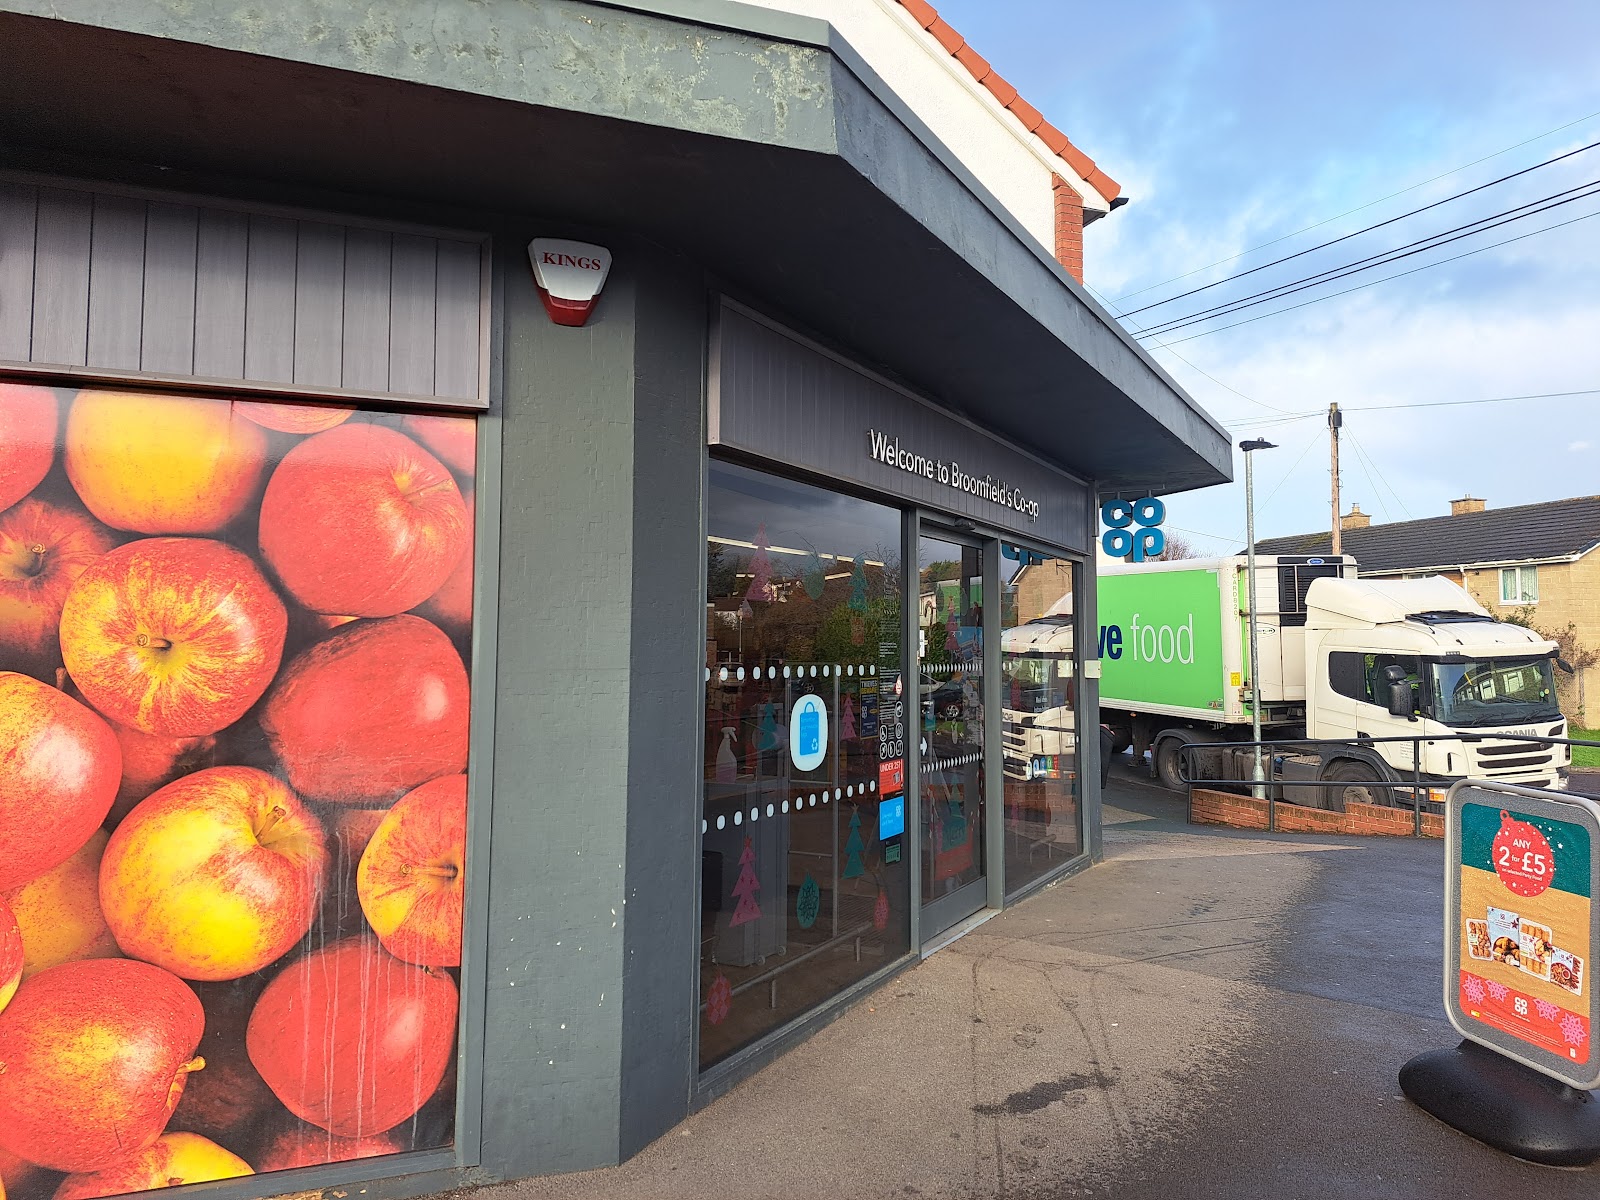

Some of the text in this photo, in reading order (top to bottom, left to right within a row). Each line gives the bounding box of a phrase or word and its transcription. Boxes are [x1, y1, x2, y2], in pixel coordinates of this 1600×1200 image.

[543, 251, 601, 271] KINGS
[870, 428, 1039, 523] Welcome to Broomfield's Co-op
[1130, 613, 1194, 665] food
[879, 762, 894, 773] UNDER
[1512, 838, 1531, 849] ANY
[1498, 846, 1546, 875] 2 for £5
